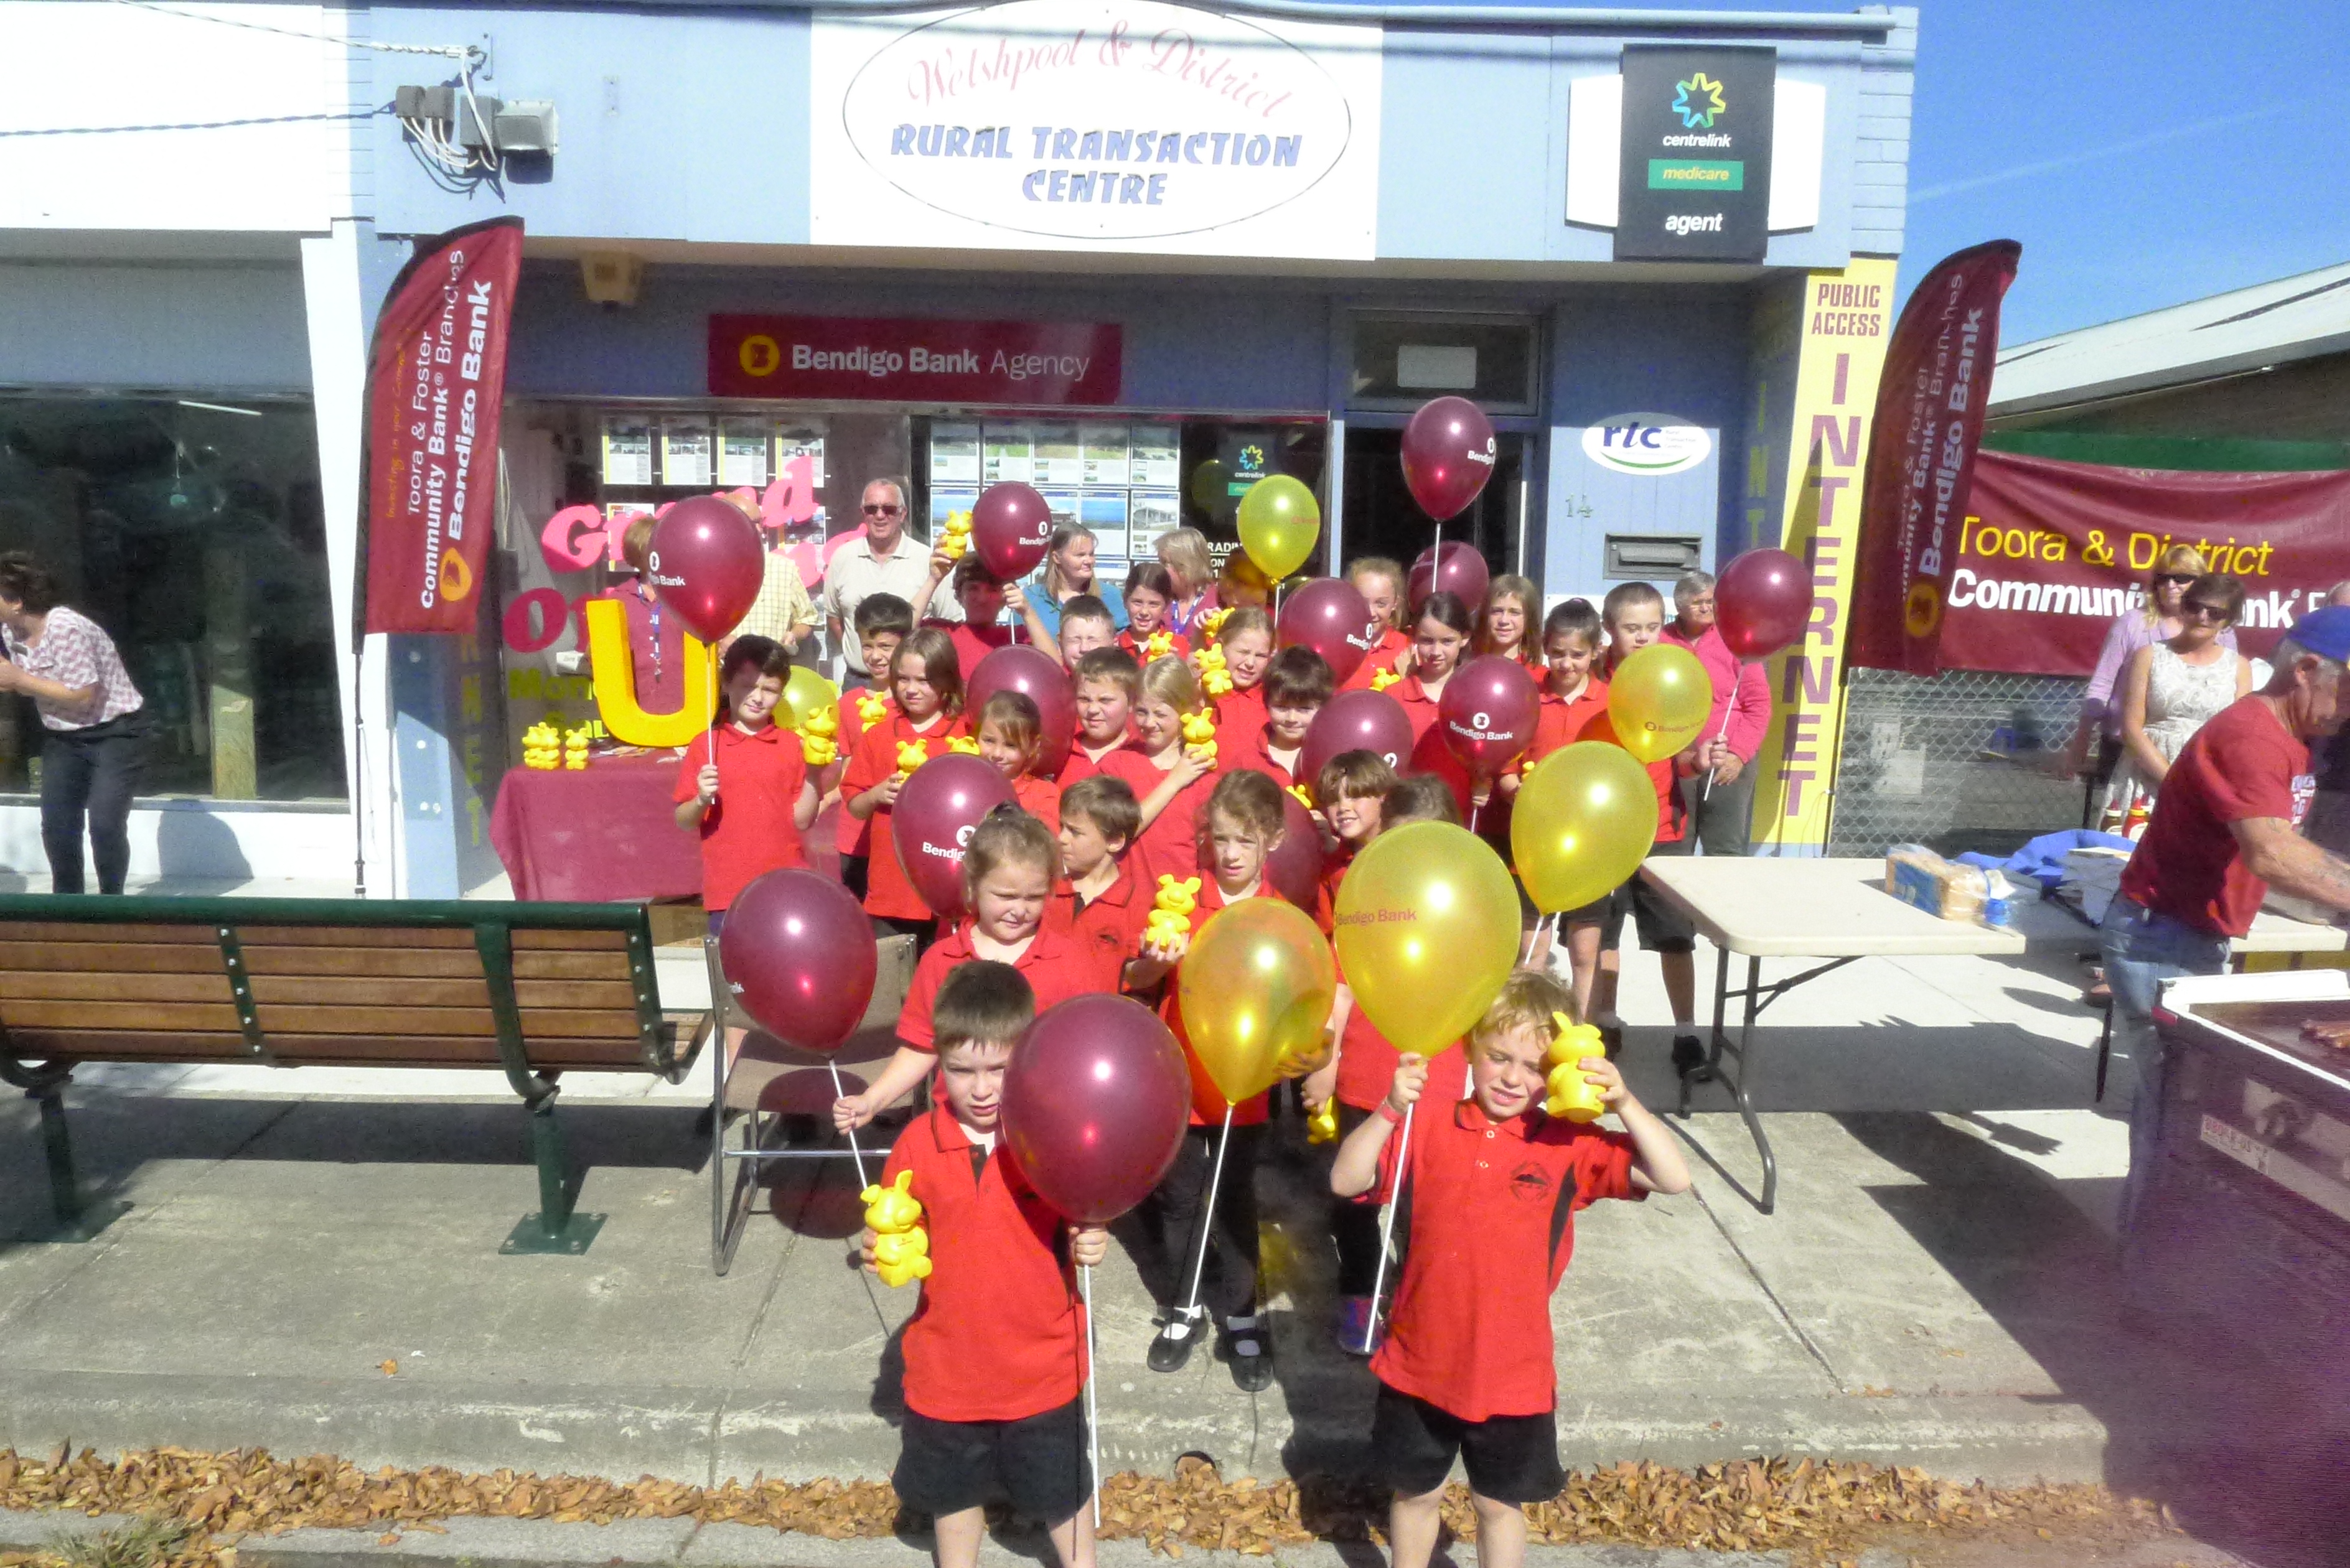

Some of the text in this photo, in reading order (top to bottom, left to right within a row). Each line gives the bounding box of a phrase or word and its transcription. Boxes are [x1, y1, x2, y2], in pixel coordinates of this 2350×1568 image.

[908, 19, 1294, 118] Welshpool & District
[891, 124, 1302, 166] RURAL TRANSACTION
[1662, 133, 1731, 148] centrelink
[1022, 170, 1167, 205] CENTRE
[1662, 166, 1730, 181] medicare
[1665, 213, 1723, 235] agent
[1817, 284, 1881, 309] PUBLIC
[1811, 312, 1881, 337] ACCESS
[792, 345, 1090, 381] Bendigo Bank Agency
[408, 330, 433, 516] Toora & Foster
[448, 279, 492, 541] Bendigo Bank
[1919, 307, 1982, 576] Bendigo Bank
[420, 464, 447, 609] Community
[1959, 516, 2069, 561] Toora
[2082, 530, 2115, 567] &
[660, 575, 686, 587] Bank
[1450, 721, 1513, 740] Bendigo Bank
[922, 842, 966, 862] Bendig
[1377, 908, 1417, 922] Bank
